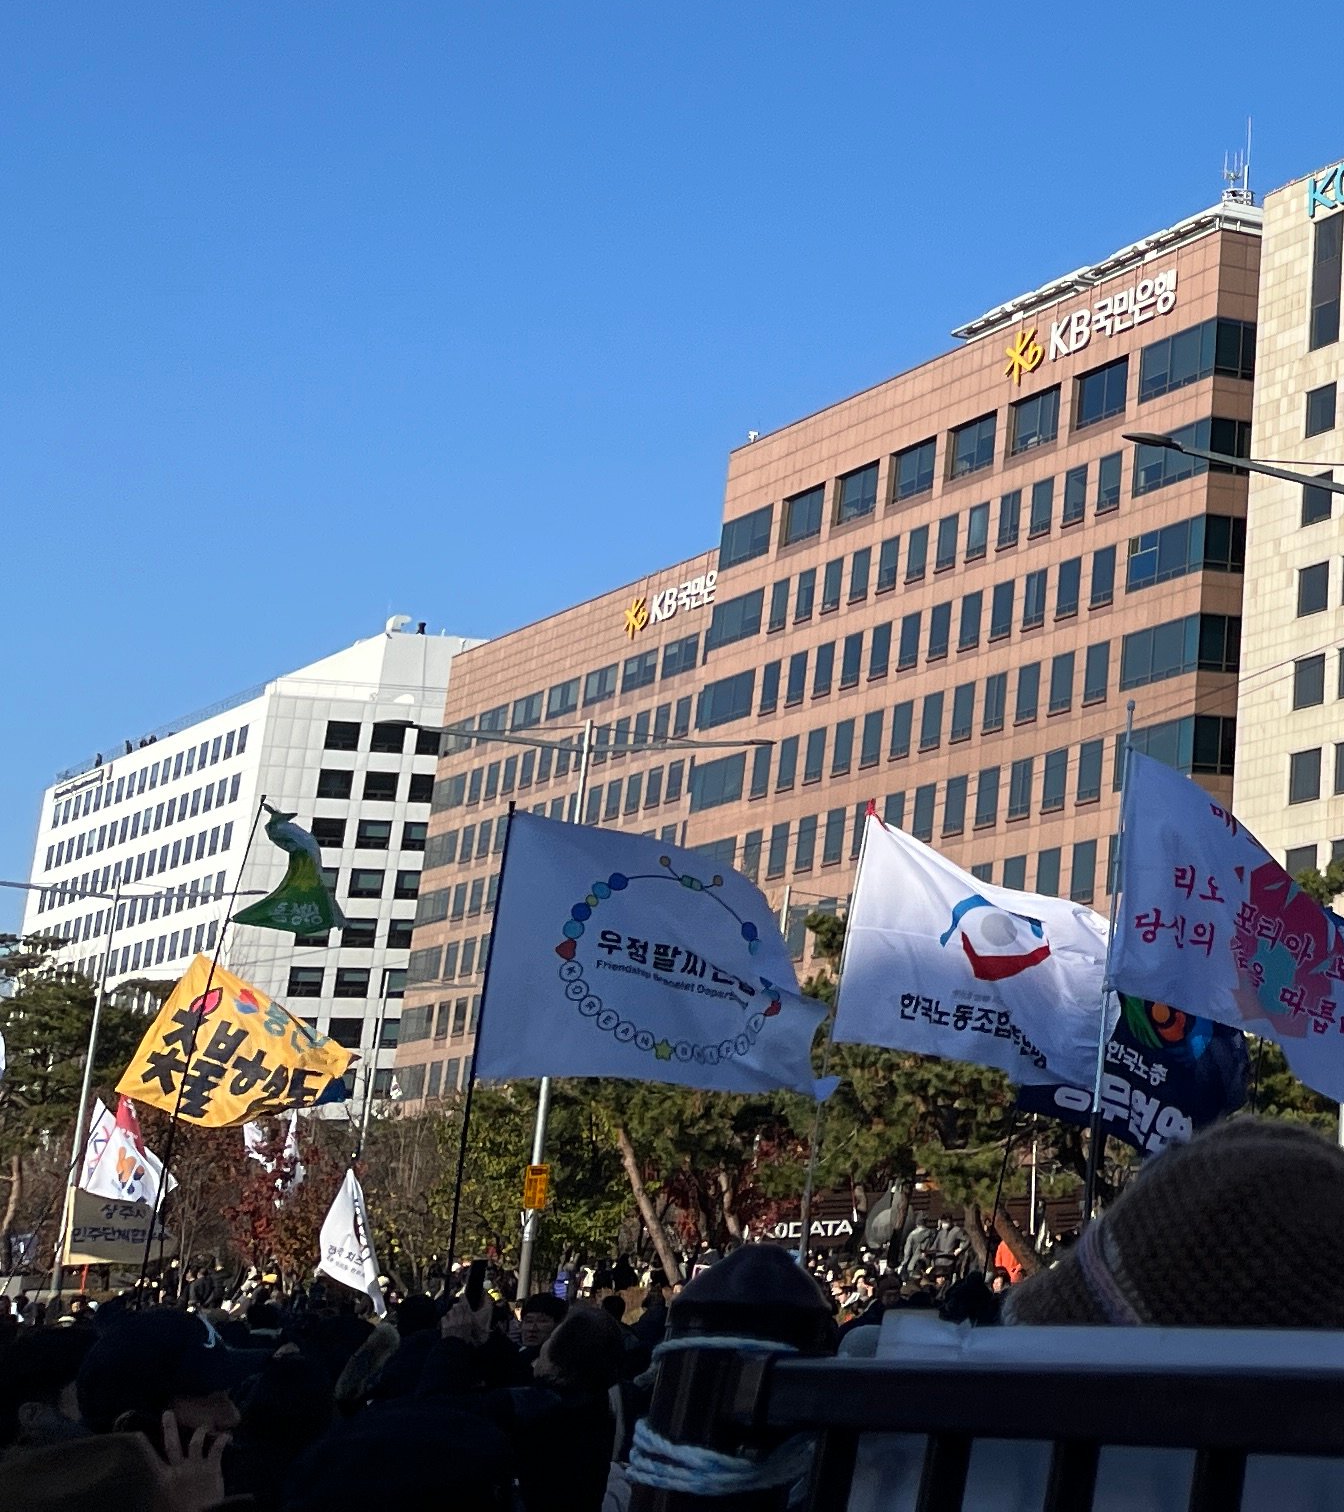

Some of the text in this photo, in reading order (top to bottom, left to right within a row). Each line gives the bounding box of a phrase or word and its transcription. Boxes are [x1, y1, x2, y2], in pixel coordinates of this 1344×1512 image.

[1050, 269, 1177, 361] KB국민은행
[1135, 908, 1215, 957] 당신의
[1105, 1040, 1169, 1087] 한국노총
